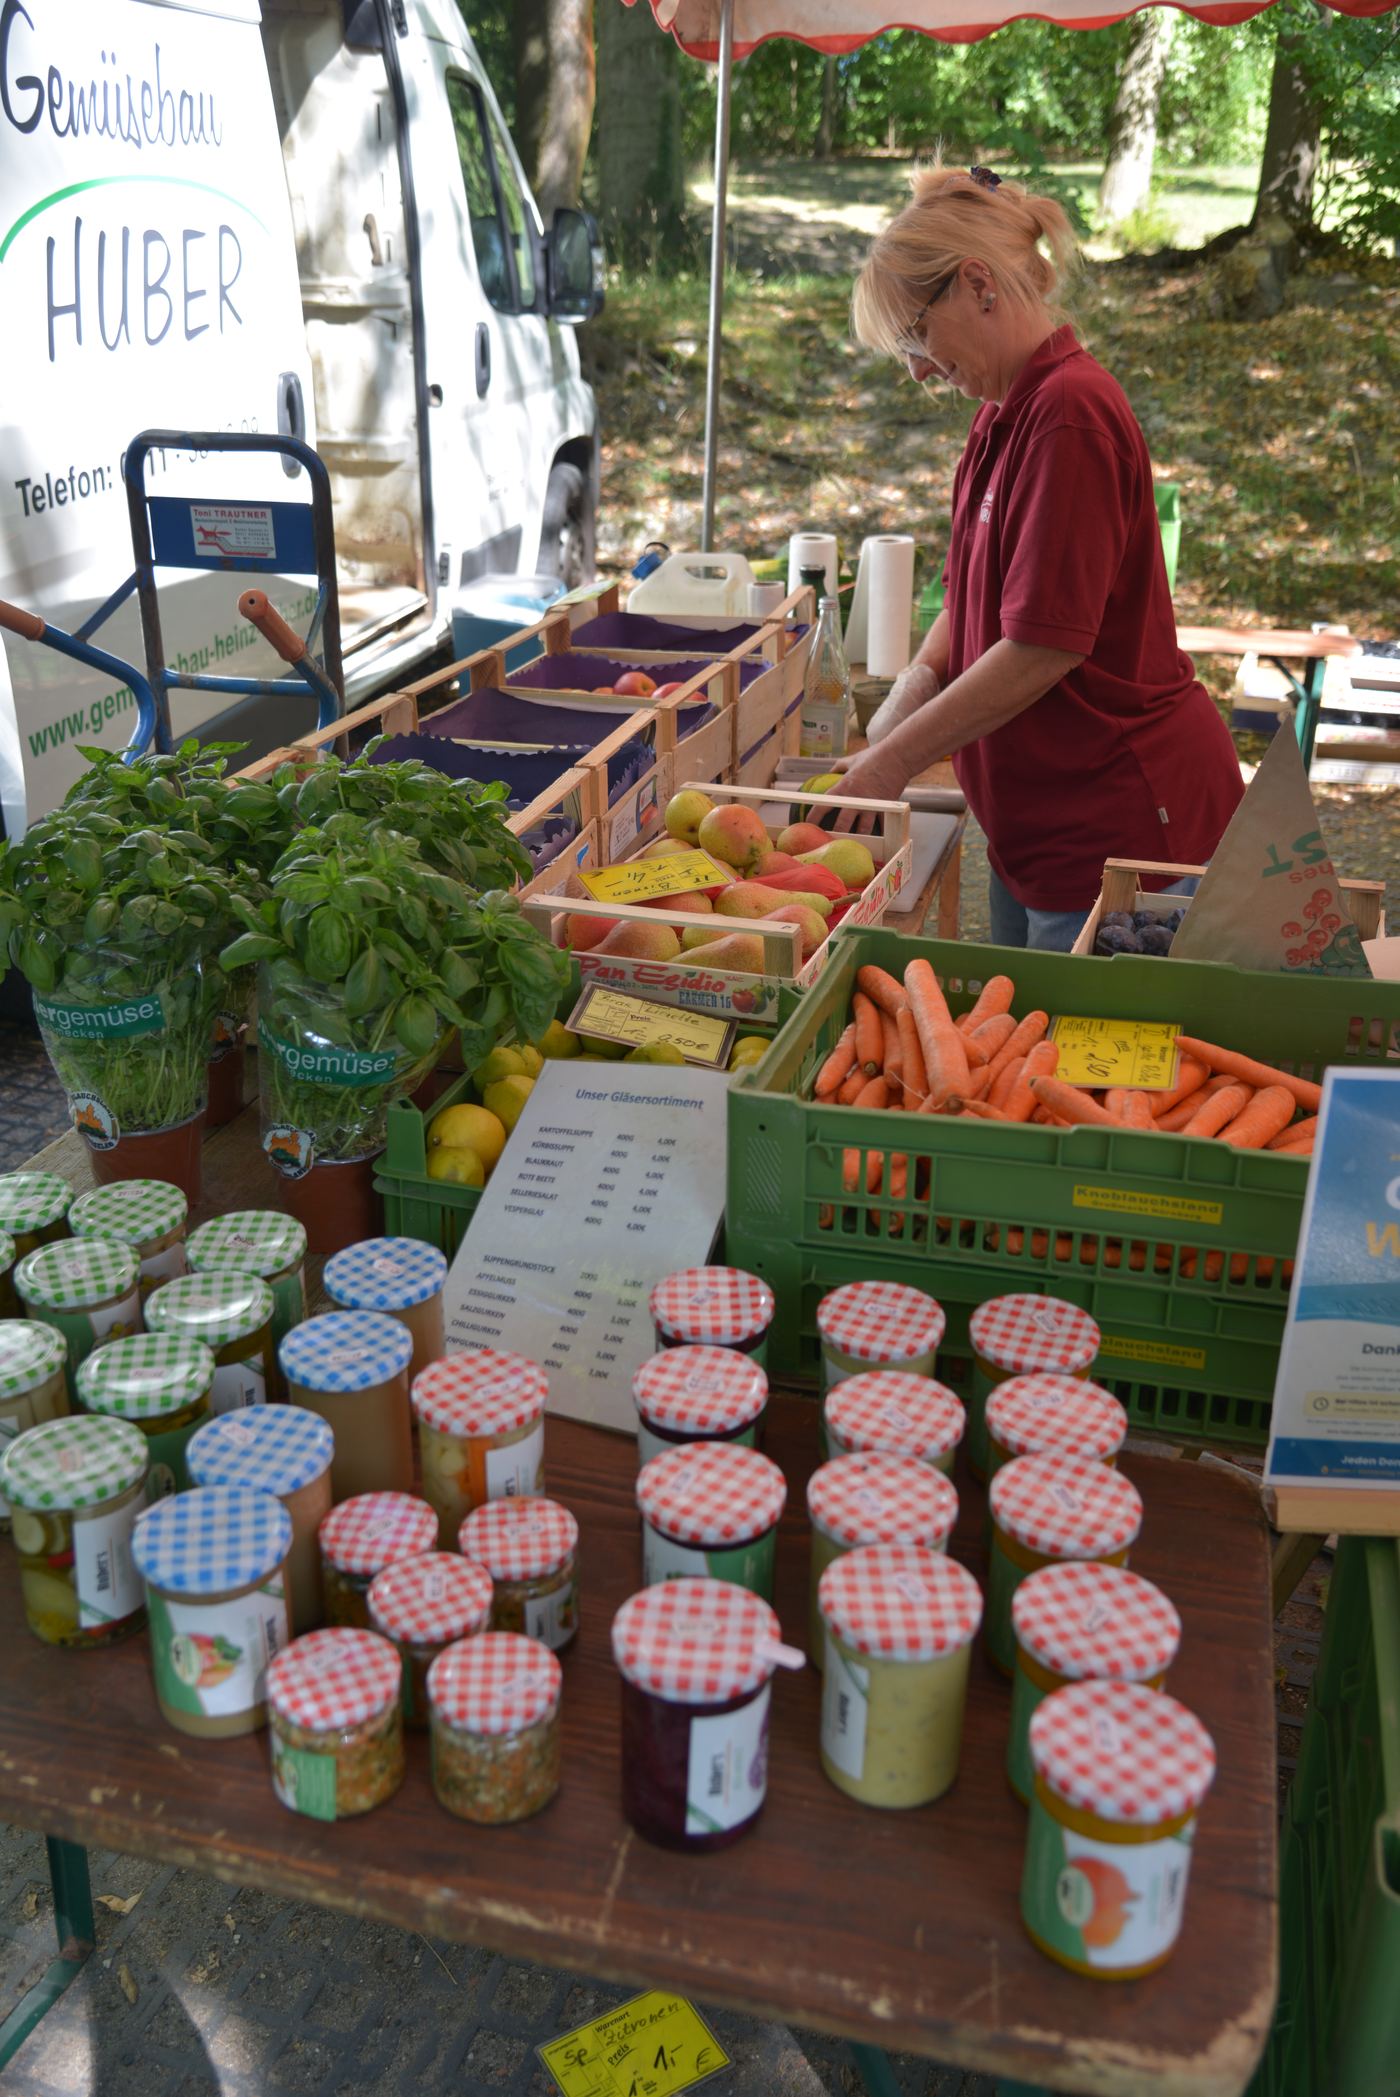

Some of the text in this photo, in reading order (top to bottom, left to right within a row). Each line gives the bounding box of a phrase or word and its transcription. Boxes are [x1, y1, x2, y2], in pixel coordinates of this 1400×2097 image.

[0, 0, 222, 149] Gemüsebau
[47, 215, 243, 362] HUBER
[15, 464, 113, 517] Telefon:
[193, 508, 268, 519] Toni TRAUTNER
[580, 956, 626, 980] Pan
[632, 963, 727, 993] Egidio
[629, 1013, 651, 1022] Preis
[575, 1088, 704, 1111] Unser Gläsersortiment
[538, 1126, 595, 1138] KARTOFFELSUPPE
[531, 1141, 576, 1153] KÜRBISSUPPE
[524, 1157, 565, 1168] BLAUKRAUT
[517, 1172, 536, 1182] ROTE
[536, 1174, 556, 1184] BEETE
[510, 1188, 559, 1201] SELLERIESALAT
[1076, 1187, 1220, 1214] Knoblauchsland
[503, 1204, 545, 1217] VESPERGLAS
[482, 1254, 557, 1274] SUPPENGRUNDSTOCK
[460, 1304, 507, 1319] SALZGURKEN
[1101, 1338, 1203, 1360] lauchsland
[1341, 1455, 1377, 1466] Jeden
[595, 2011, 631, 2033] Warenart
[603, 2002, 680, 2047] Zitronen
[607, 2043, 631, 2067] Preis
